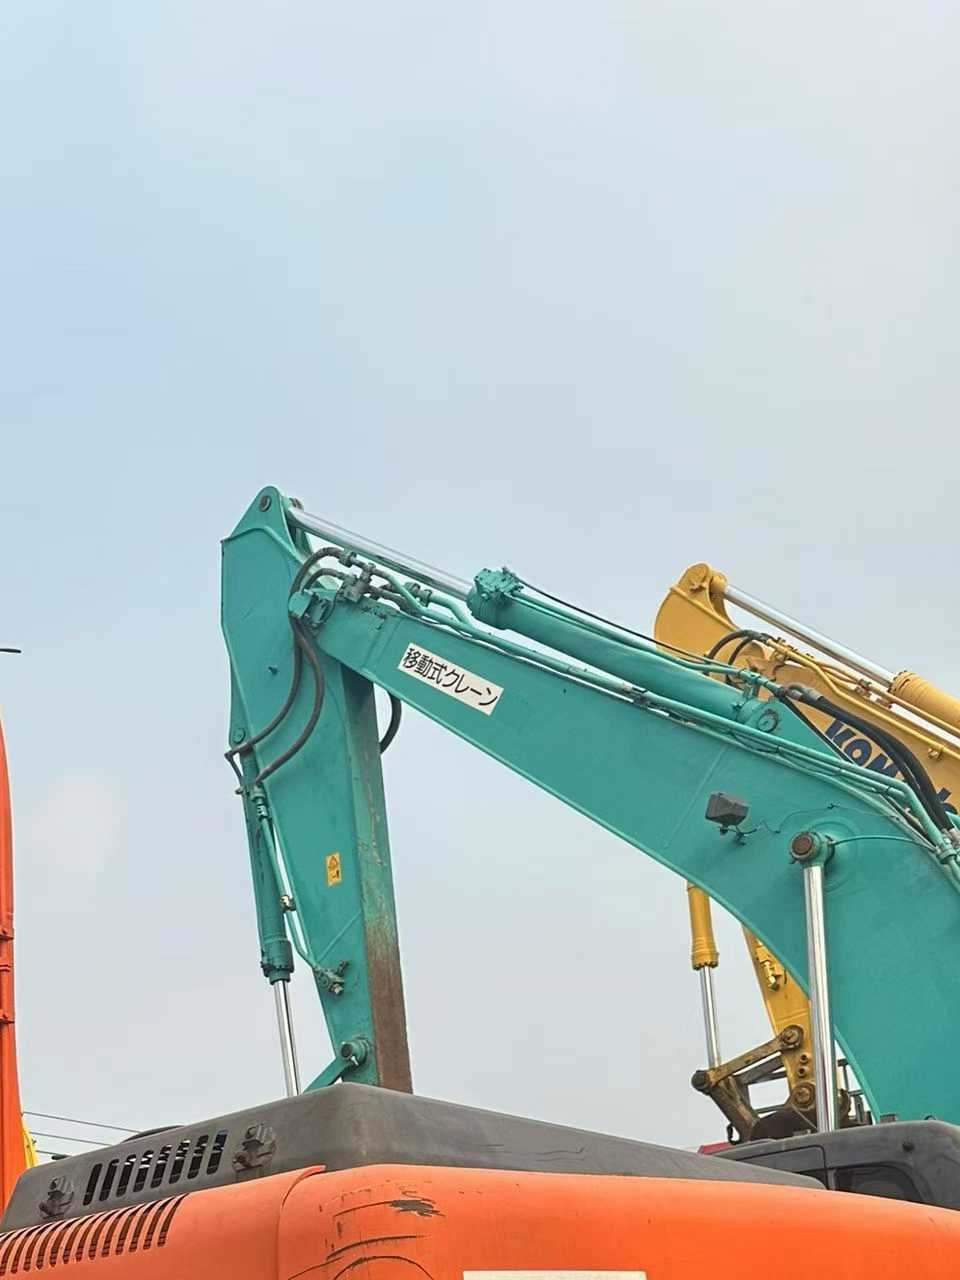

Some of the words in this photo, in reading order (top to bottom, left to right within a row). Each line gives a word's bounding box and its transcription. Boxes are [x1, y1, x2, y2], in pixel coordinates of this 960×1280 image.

[402, 647, 499, 706] 移動式クレーン
